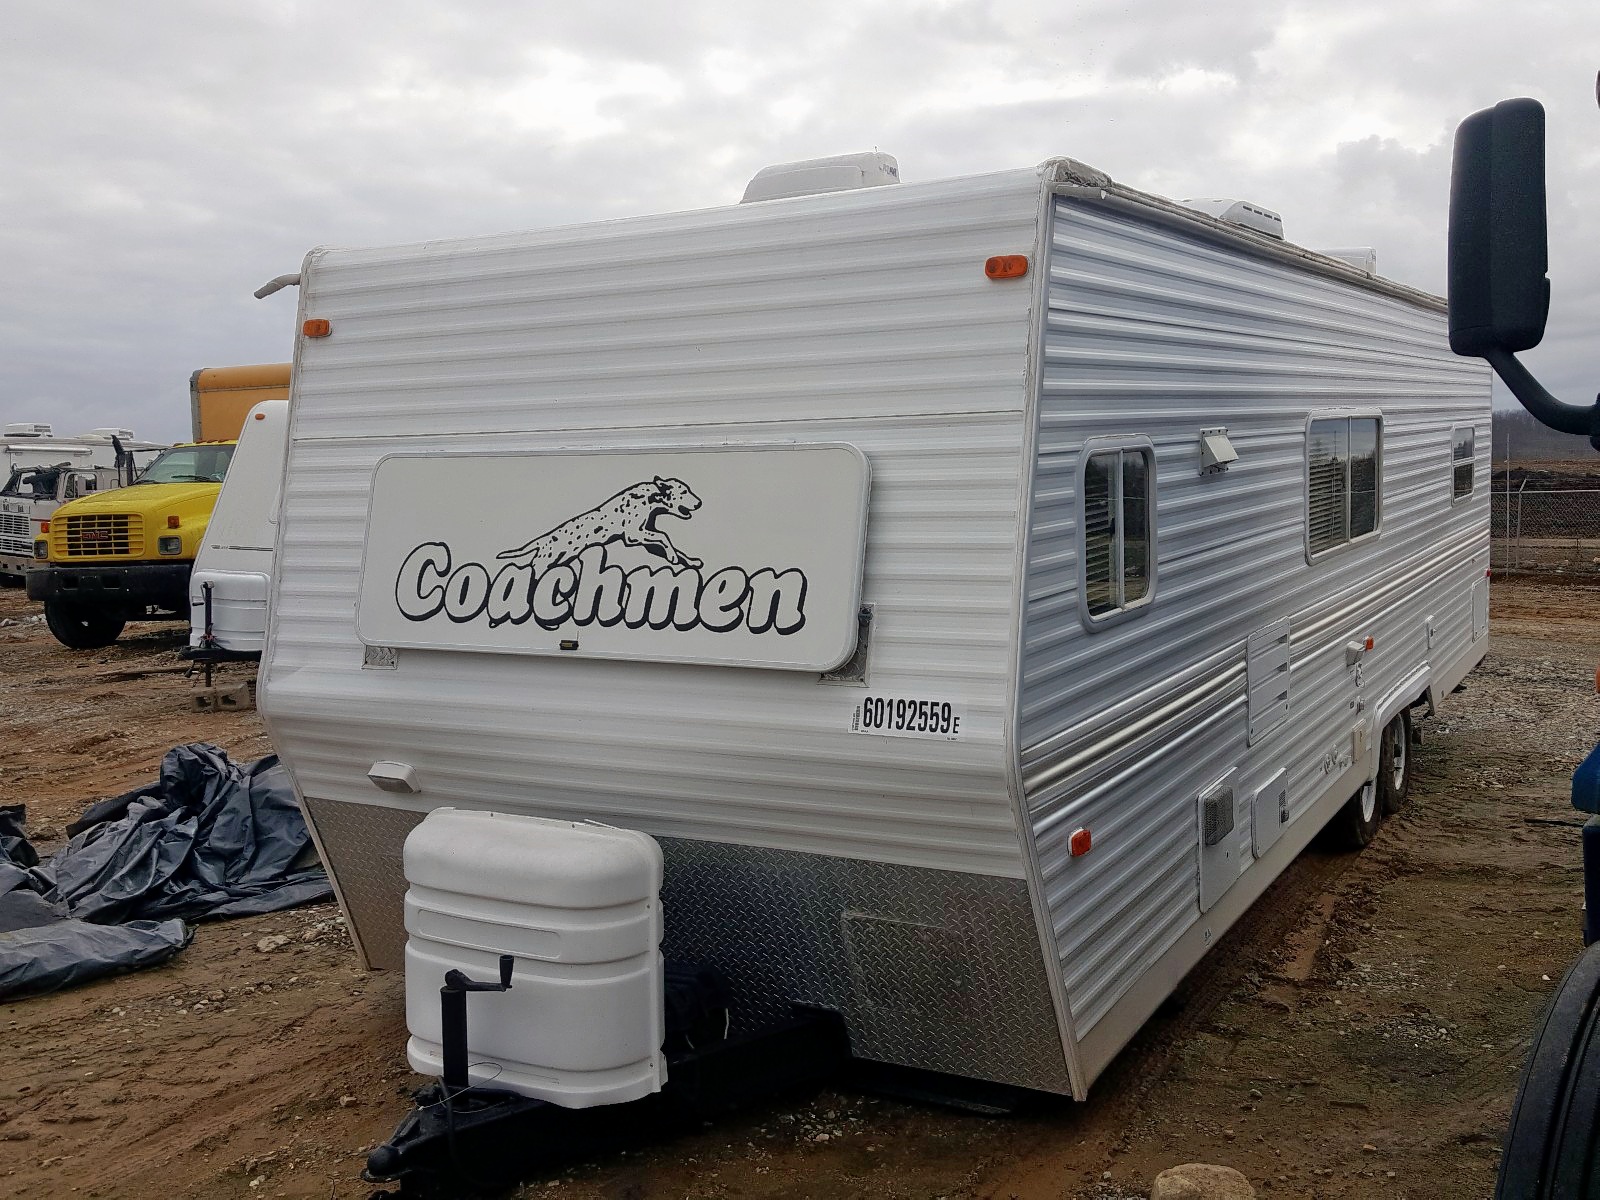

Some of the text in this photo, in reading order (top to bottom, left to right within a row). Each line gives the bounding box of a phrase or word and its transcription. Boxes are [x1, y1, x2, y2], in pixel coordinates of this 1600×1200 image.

[81, 530, 109, 541] GMC
[395, 542, 808, 636] Coachmen
[863, 696, 952, 734] 60192559
